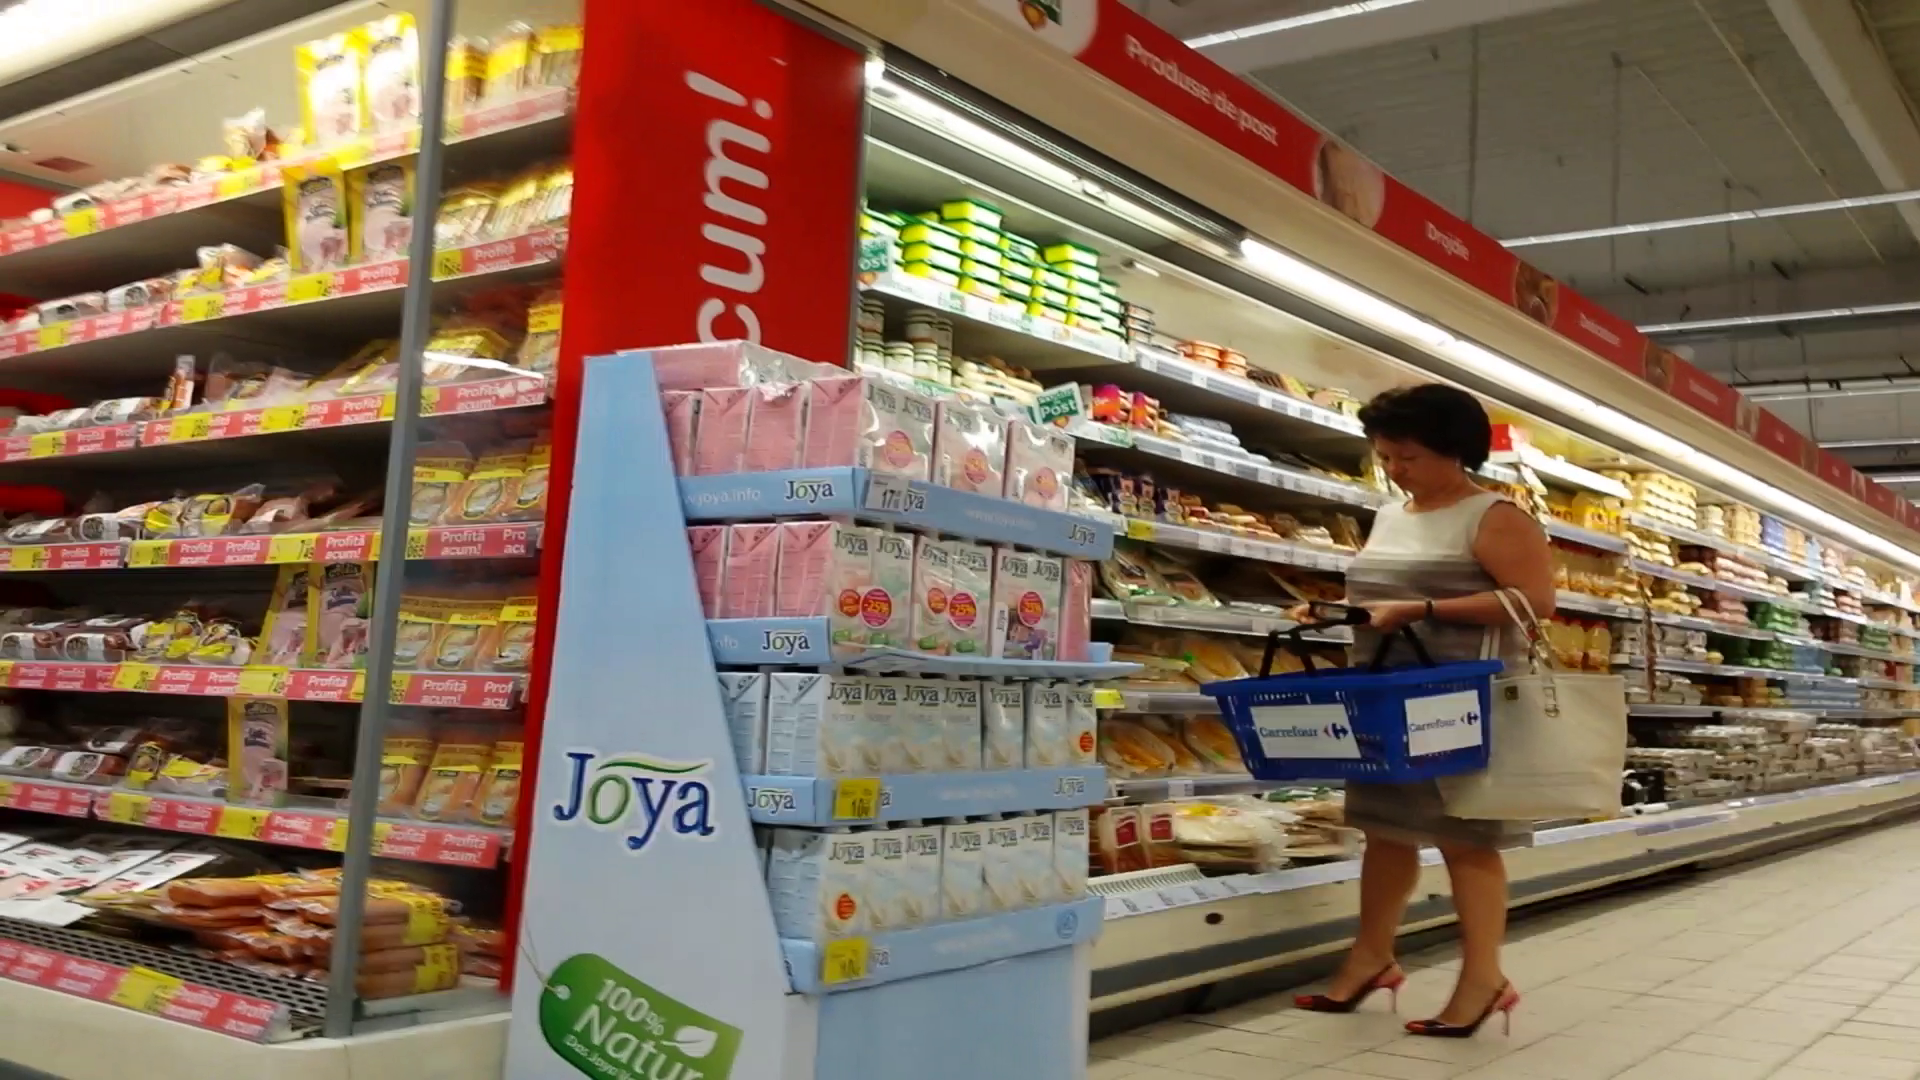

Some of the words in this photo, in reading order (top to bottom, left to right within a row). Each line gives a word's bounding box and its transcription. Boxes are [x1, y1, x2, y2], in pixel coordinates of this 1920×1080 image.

[1126, 33, 1211, 104] Produse
[1213, 90, 1238, 120] de
[1238, 108, 1279, 147] post
[859, 253, 888, 271] ost
[786, 479, 834, 503] Joya
[441, 530, 485, 543] Profită
[1068, 522, 1097, 545] Joya
[440, 543, 482, 556] acum!
[863, 600, 890, 614] -25%
[949, 603, 976, 616] -25%
[762, 630, 810, 655] Joya
[422, 679, 468, 692] Profită
[1259, 726, 1319, 738] Carrefour
[1409, 716, 1456, 732] Carrefour
[553, 752, 715, 851] Joya
[747, 788, 795, 813] Joya
[598, 978, 666, 1036] 100%
